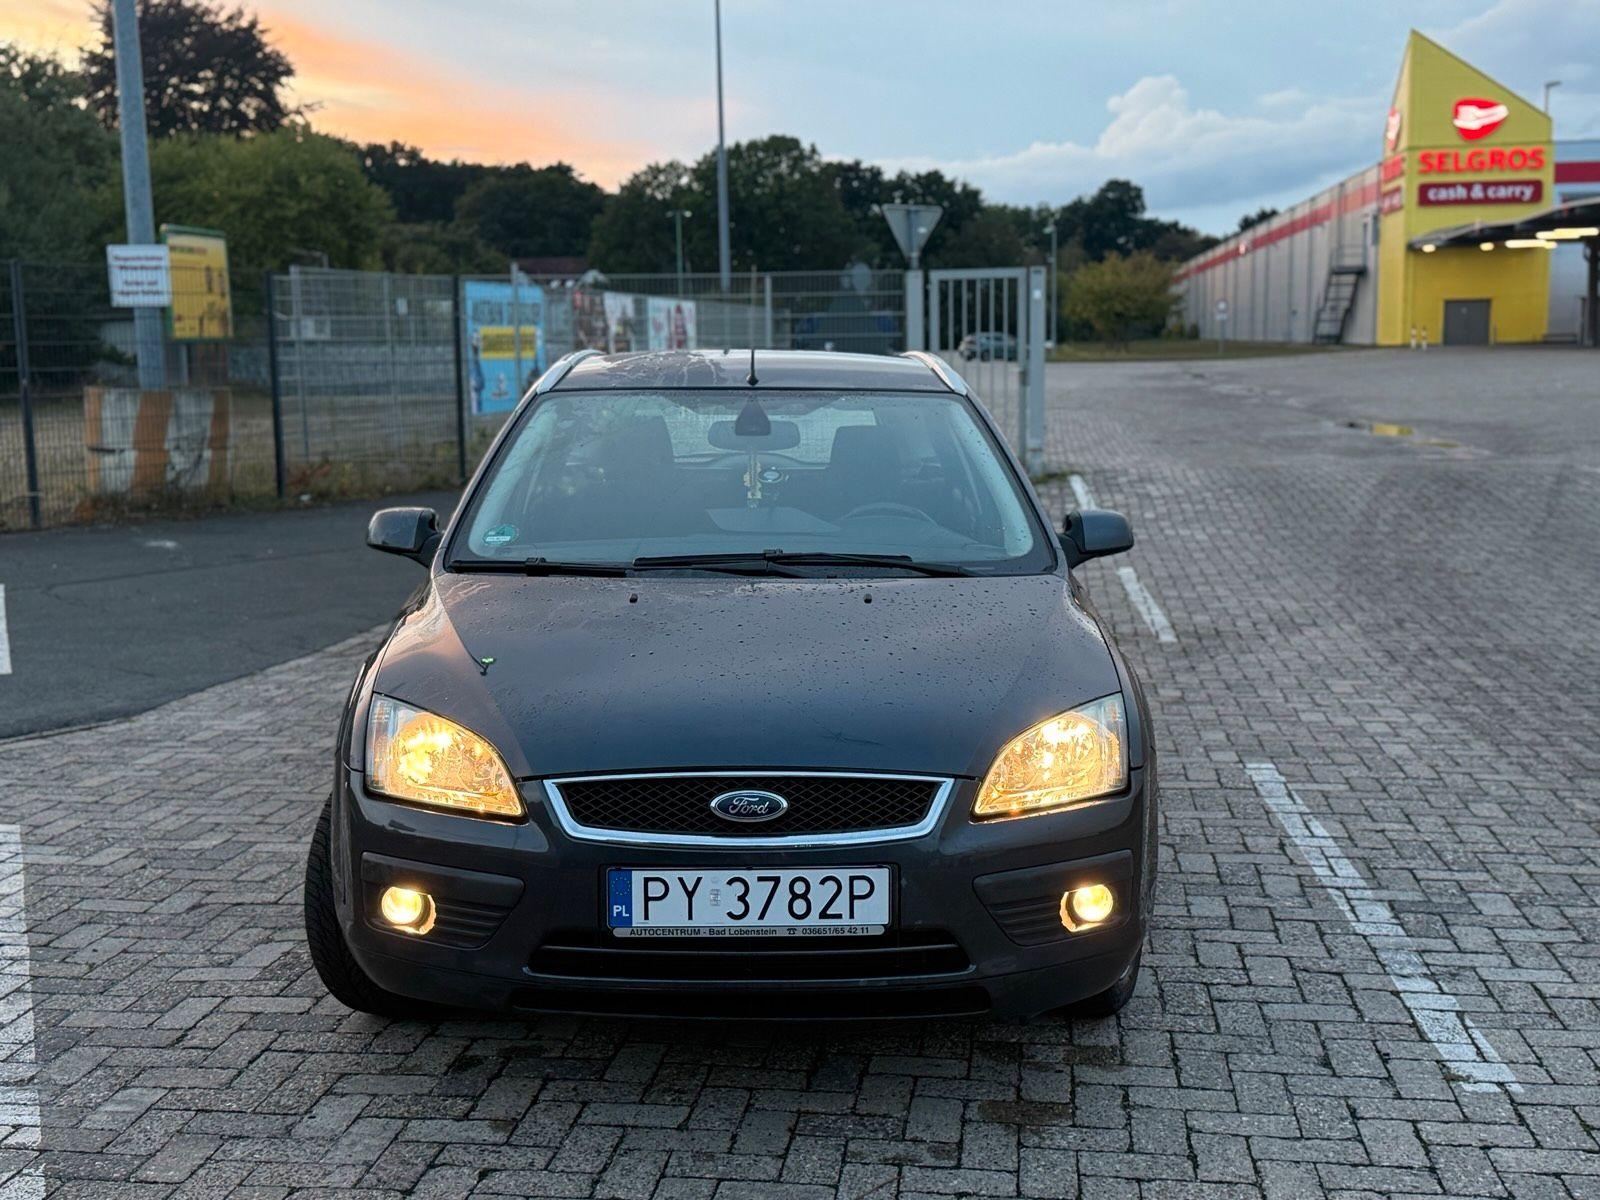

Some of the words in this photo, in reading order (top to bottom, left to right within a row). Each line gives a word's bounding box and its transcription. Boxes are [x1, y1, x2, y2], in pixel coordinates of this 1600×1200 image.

[1418, 147, 1545, 175] SELGROS
[1427, 184, 1466, 200] cash
[1469, 184, 1485, 200] &
[1486, 183, 1534, 204] carry
[728, 796, 770, 814] Ford
[643, 876, 703, 921] PY
[725, 875, 875, 921] 3782P
[612, 905, 630, 917] PL
[629, 928, 701, 936] AUTOCENTRUM
[708, 928, 726, 936] Bad
[728, 927, 777, 936] Lobenstein
[801, 927, 845, 935] 036651/65
[847, 926, 858, 934] 42
[861, 926, 870, 934] 11
